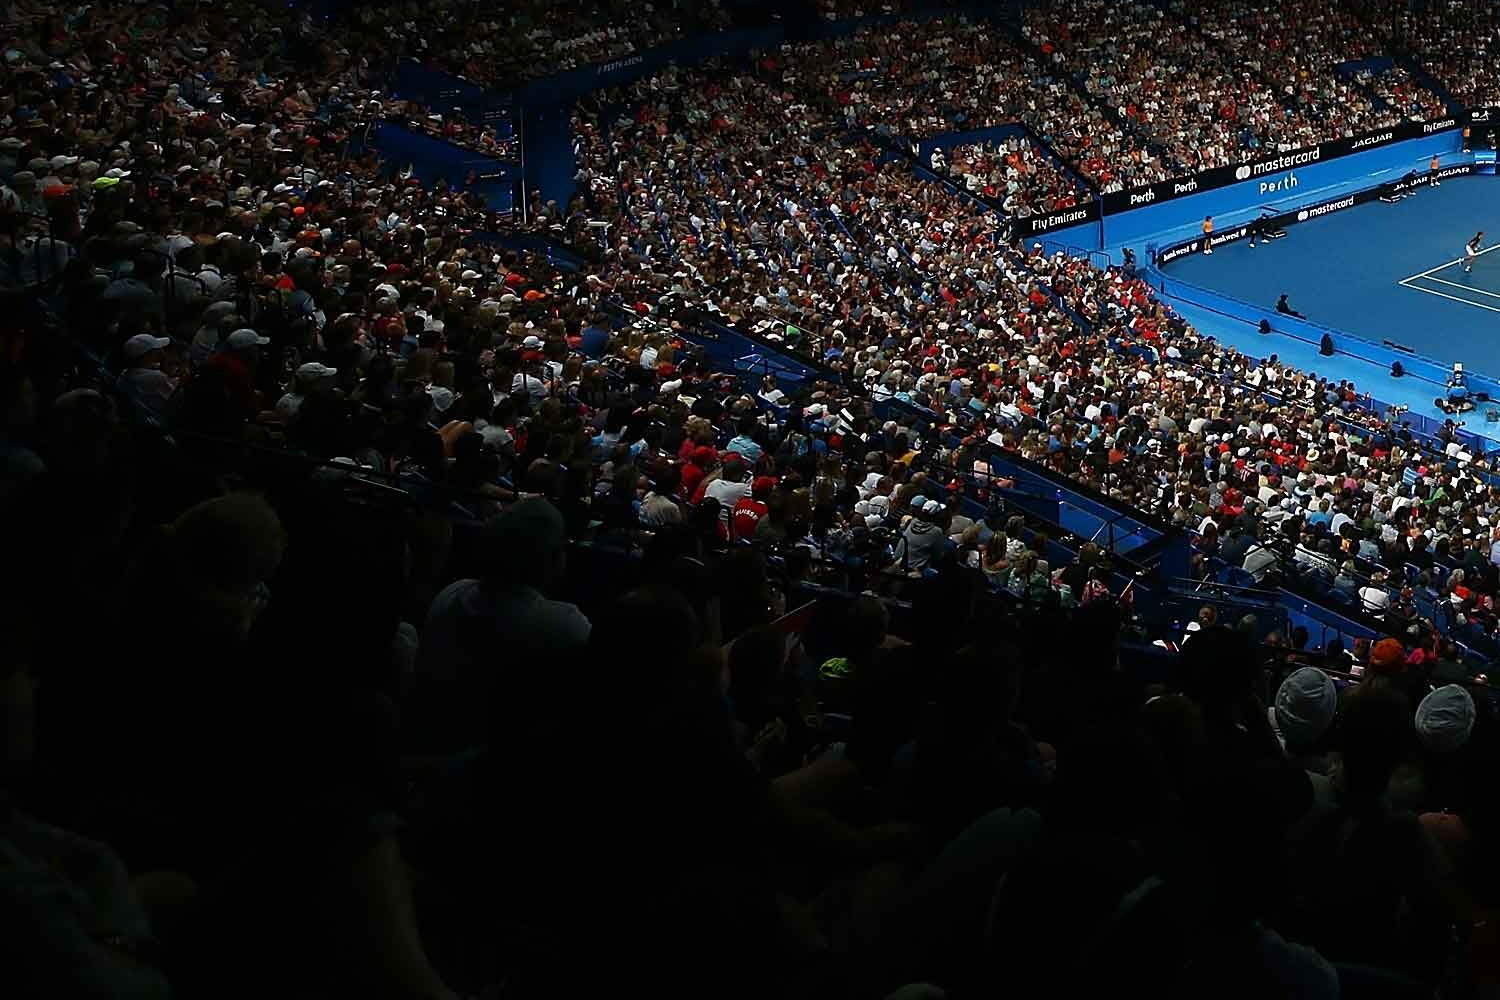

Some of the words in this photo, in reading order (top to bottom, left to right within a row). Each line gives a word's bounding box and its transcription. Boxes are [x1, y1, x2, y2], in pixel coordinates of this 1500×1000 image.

[1351, 132, 1393, 149] JAGUAR
[1253, 147, 1320, 175] mastercard
[1436, 166, 1470, 180] AGUAR
[1174, 178, 1198, 195] Perth
[1259, 172, 1298, 195] Perth
[1393, 176, 1428, 191] JAUAR
[1130, 189, 1155, 205] Perth
[1309, 195, 1354, 217] mastercard
[1032, 218, 1048, 231] Fly
[1049, 209, 1087, 226] Emirates
[735, 508, 759, 521] SUISSE
